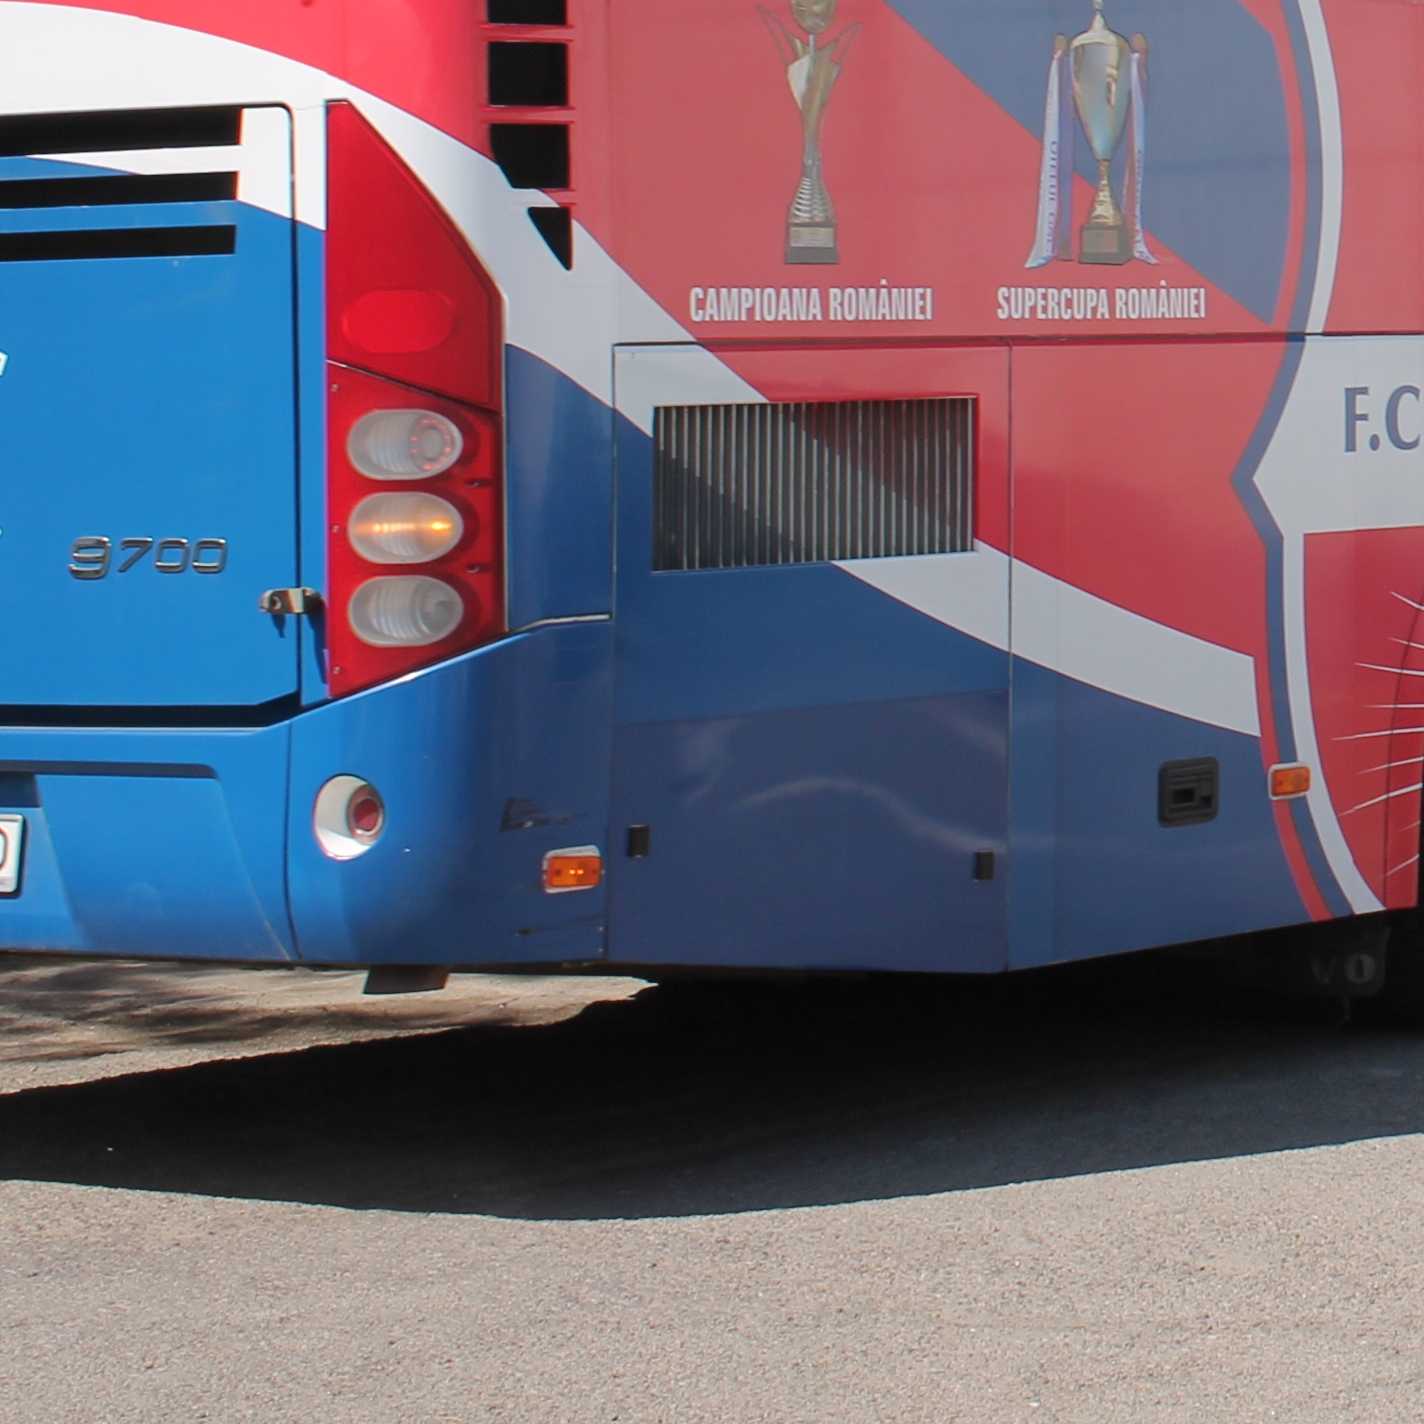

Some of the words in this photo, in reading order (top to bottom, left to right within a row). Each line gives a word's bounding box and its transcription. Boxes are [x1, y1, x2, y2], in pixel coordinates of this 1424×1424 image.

[689, 286, 822, 322] CAMPIOANA
[829, 278, 932, 321] ROMÂNIEI
[997, 286, 1110, 320] SUPERCUPA
[1115, 279, 1206, 319] ROMÂNIEI
[68, 536, 228, 581] 9700
